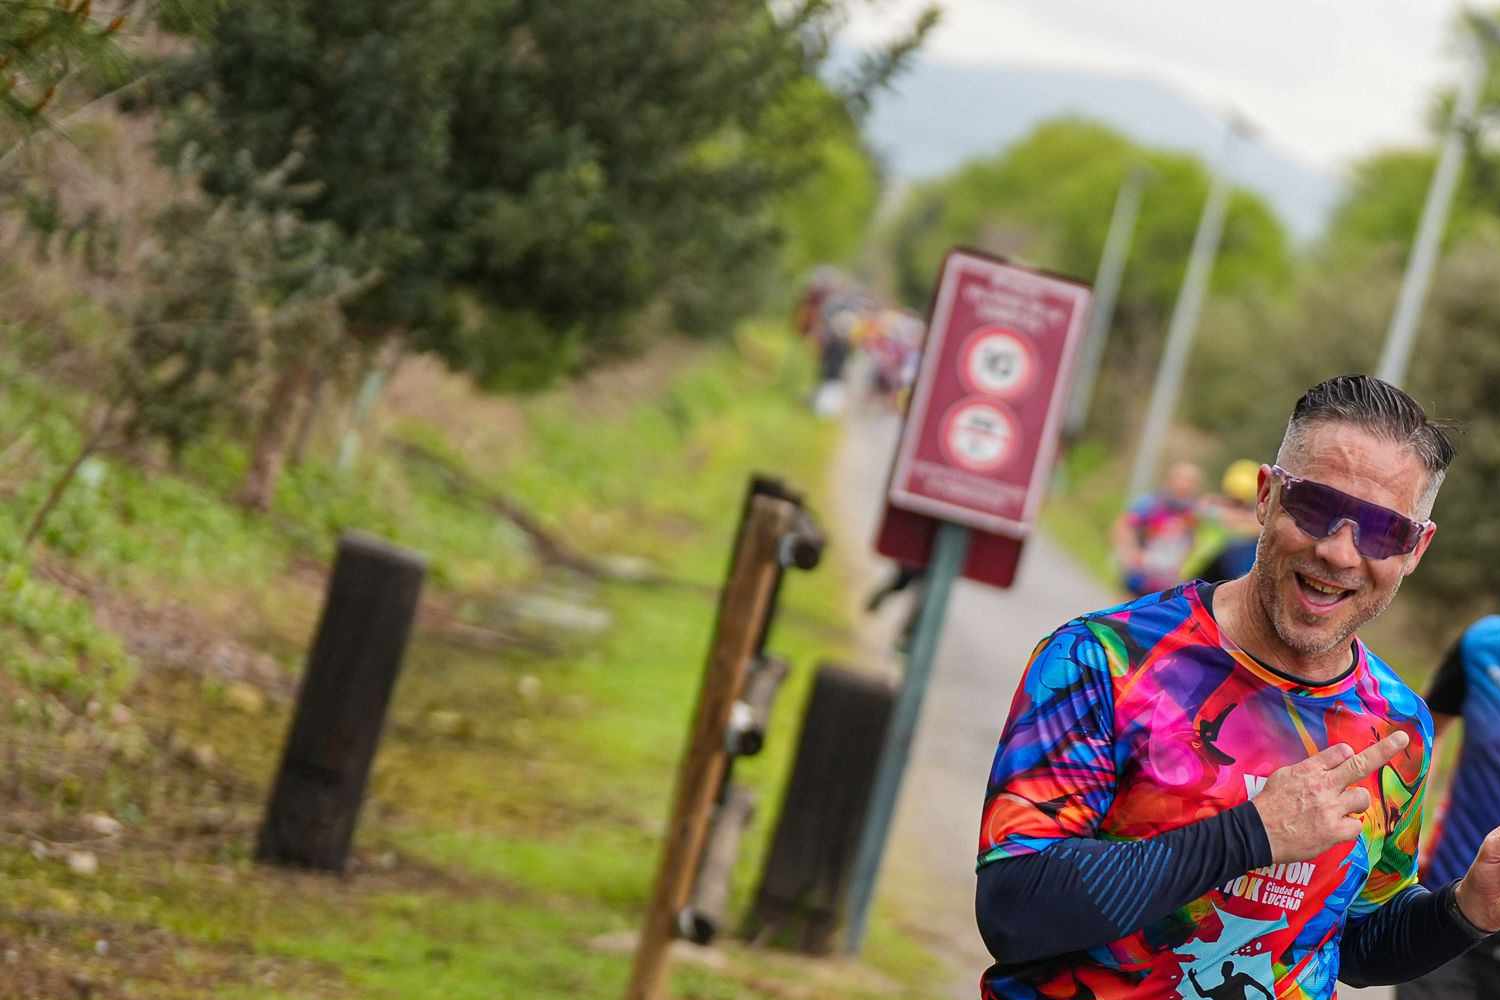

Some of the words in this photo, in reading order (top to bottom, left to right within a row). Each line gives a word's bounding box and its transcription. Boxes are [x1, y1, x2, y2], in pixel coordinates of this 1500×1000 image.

[1223, 874, 1265, 902] 10K
[1265, 881, 1294, 895] Ciudad
[1293, 887, 1305, 899] de
[1261, 891, 1302, 911] LUCENA
